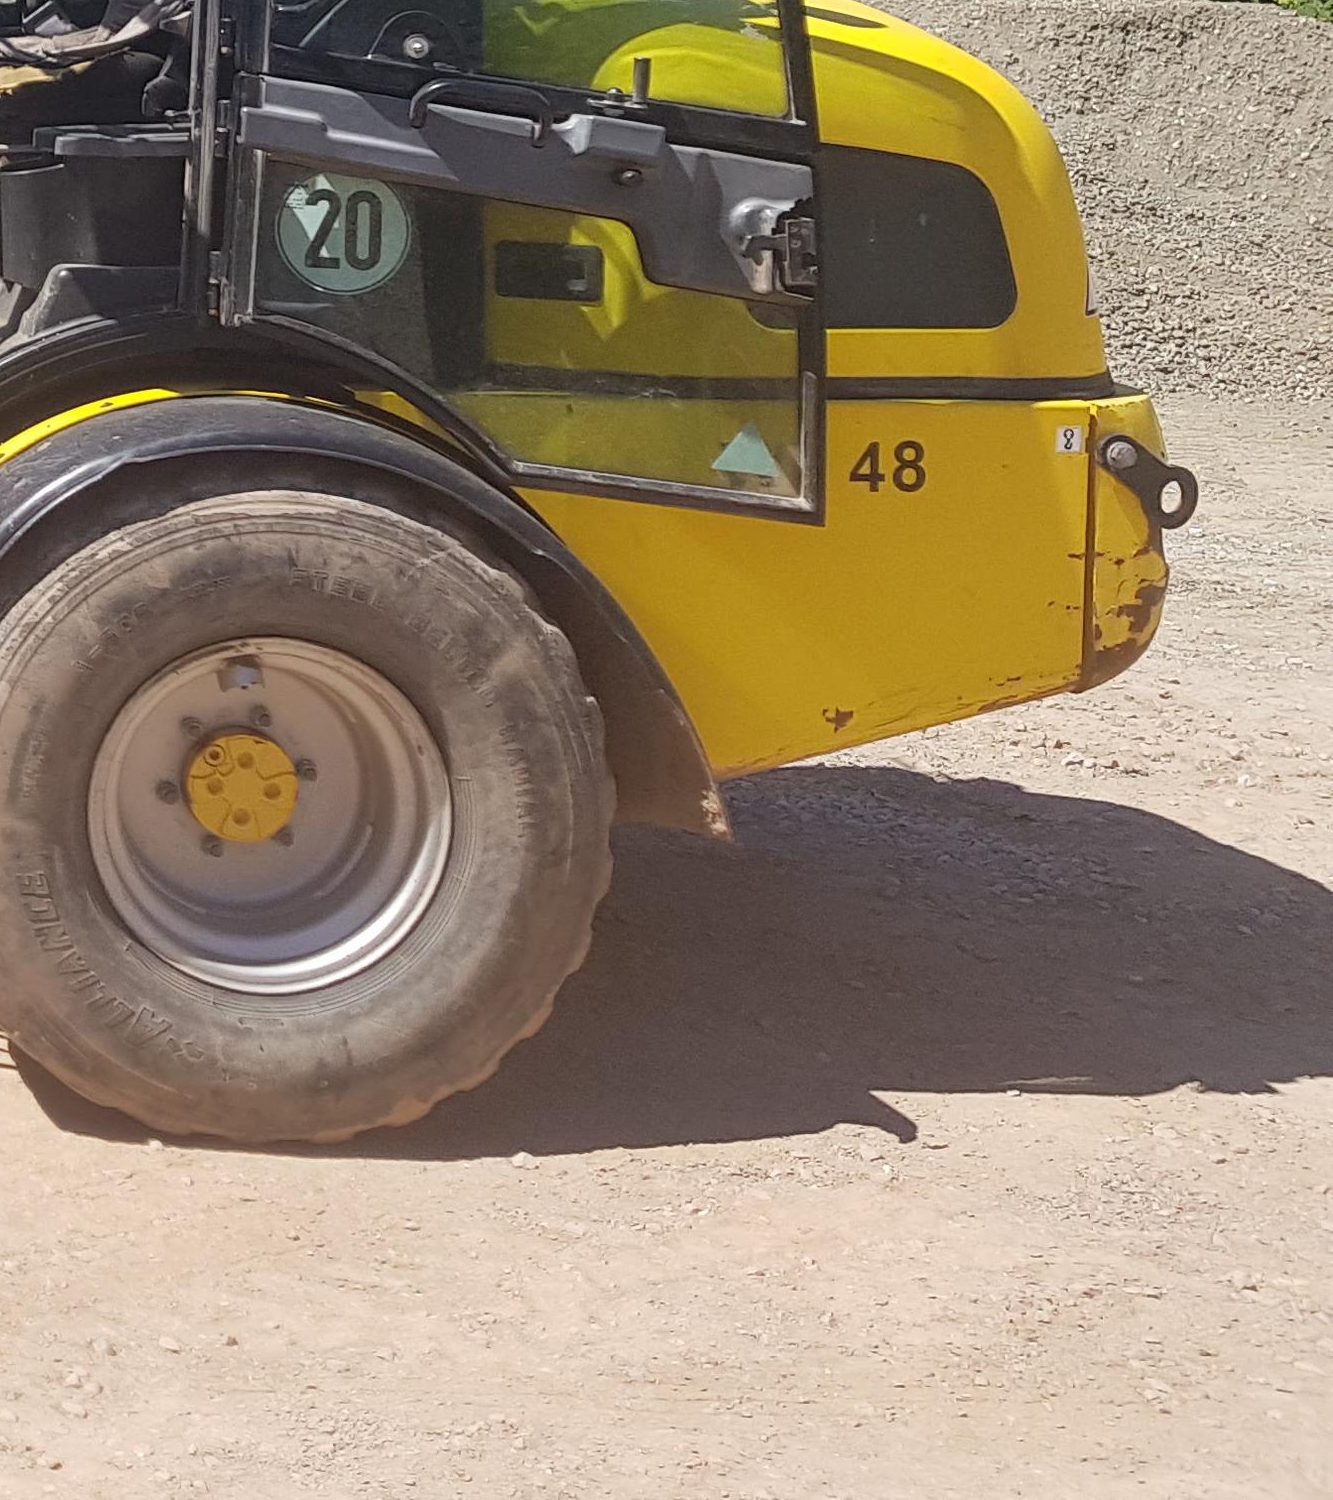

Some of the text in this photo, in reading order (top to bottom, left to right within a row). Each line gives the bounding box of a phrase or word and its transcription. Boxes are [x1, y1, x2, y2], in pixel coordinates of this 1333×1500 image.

[304, 188, 382, 271] 20
[849, 440, 927, 493] 48
[15, 869, 173, 1048] ALLIANCE
